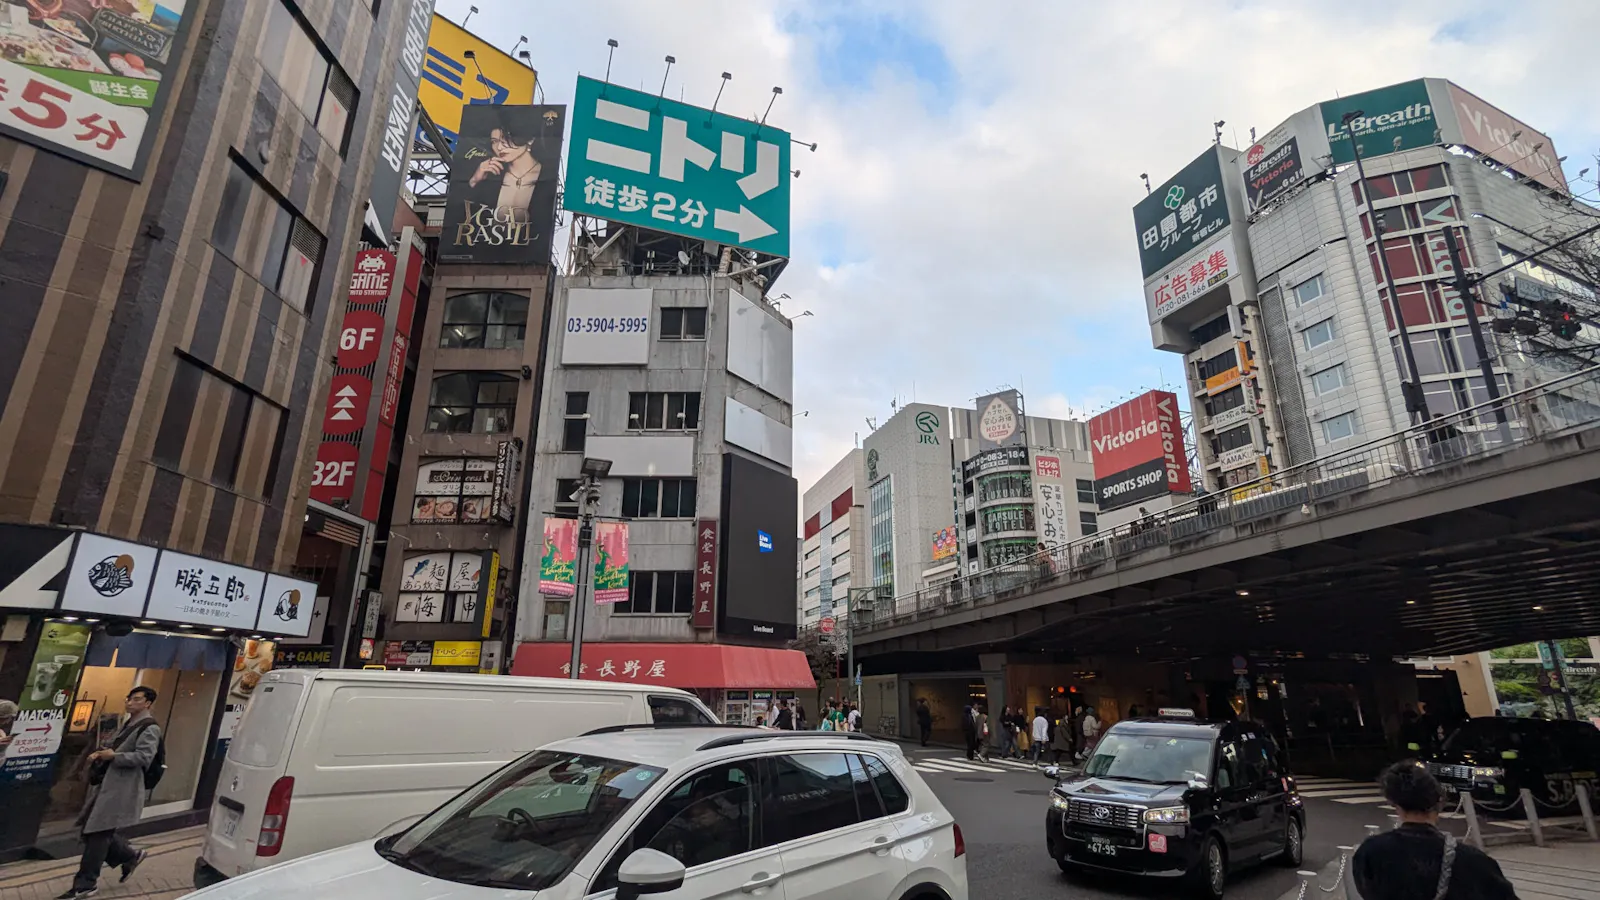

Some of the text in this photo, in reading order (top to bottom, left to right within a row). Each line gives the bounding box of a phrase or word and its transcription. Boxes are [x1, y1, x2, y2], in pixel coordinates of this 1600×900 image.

[88, 79, 149, 100] 誕生会
[0, 78, 127, 150] 5分
[382, 83, 413, 173] TOWER
[1328, 102, 1431, 137] L-Breath
[1377, 120, 1407, 132] open-air
[1408, 115, 1431, 125] sports
[586, 98, 780, 200] ニトリ
[1249, 144, 1292, 179] L-Breath
[1252, 159, 1294, 189] Victoria
[1282, 167, 1304, 188] Golf
[584, 175, 709, 229] 徒歩2分
[1142, 184, 1218, 250] 田園都市
[1160, 214, 1203, 252] グループ
[350, 272, 390, 290] GAME
[1154, 249, 1228, 308] 広告募集
[1156, 284, 1207, 316] 0120-081-666
[339, 327, 376, 351] 6F
[567, 317, 648, 333] 03-5904-5995
[917, 434, 940, 445] JRA
[986, 423, 1011, 433] HOTEL
[1093, 419, 1158, 455] Victoria
[1157, 397, 1181, 484] Victoria
[969, 451, 1026, 471] 0120-083-184
[986, 488, 1022, 500] LUXURY
[1103, 469, 1163, 499] SPORTS SHOP
[987, 510, 1024, 523] CAPSULE
[175, 568, 245, 602] 勝五郎
[296, 651, 332, 663] GAME
[18, 708, 64, 721] MATCHA
[1091, 840, 1117, 857] 67-95
